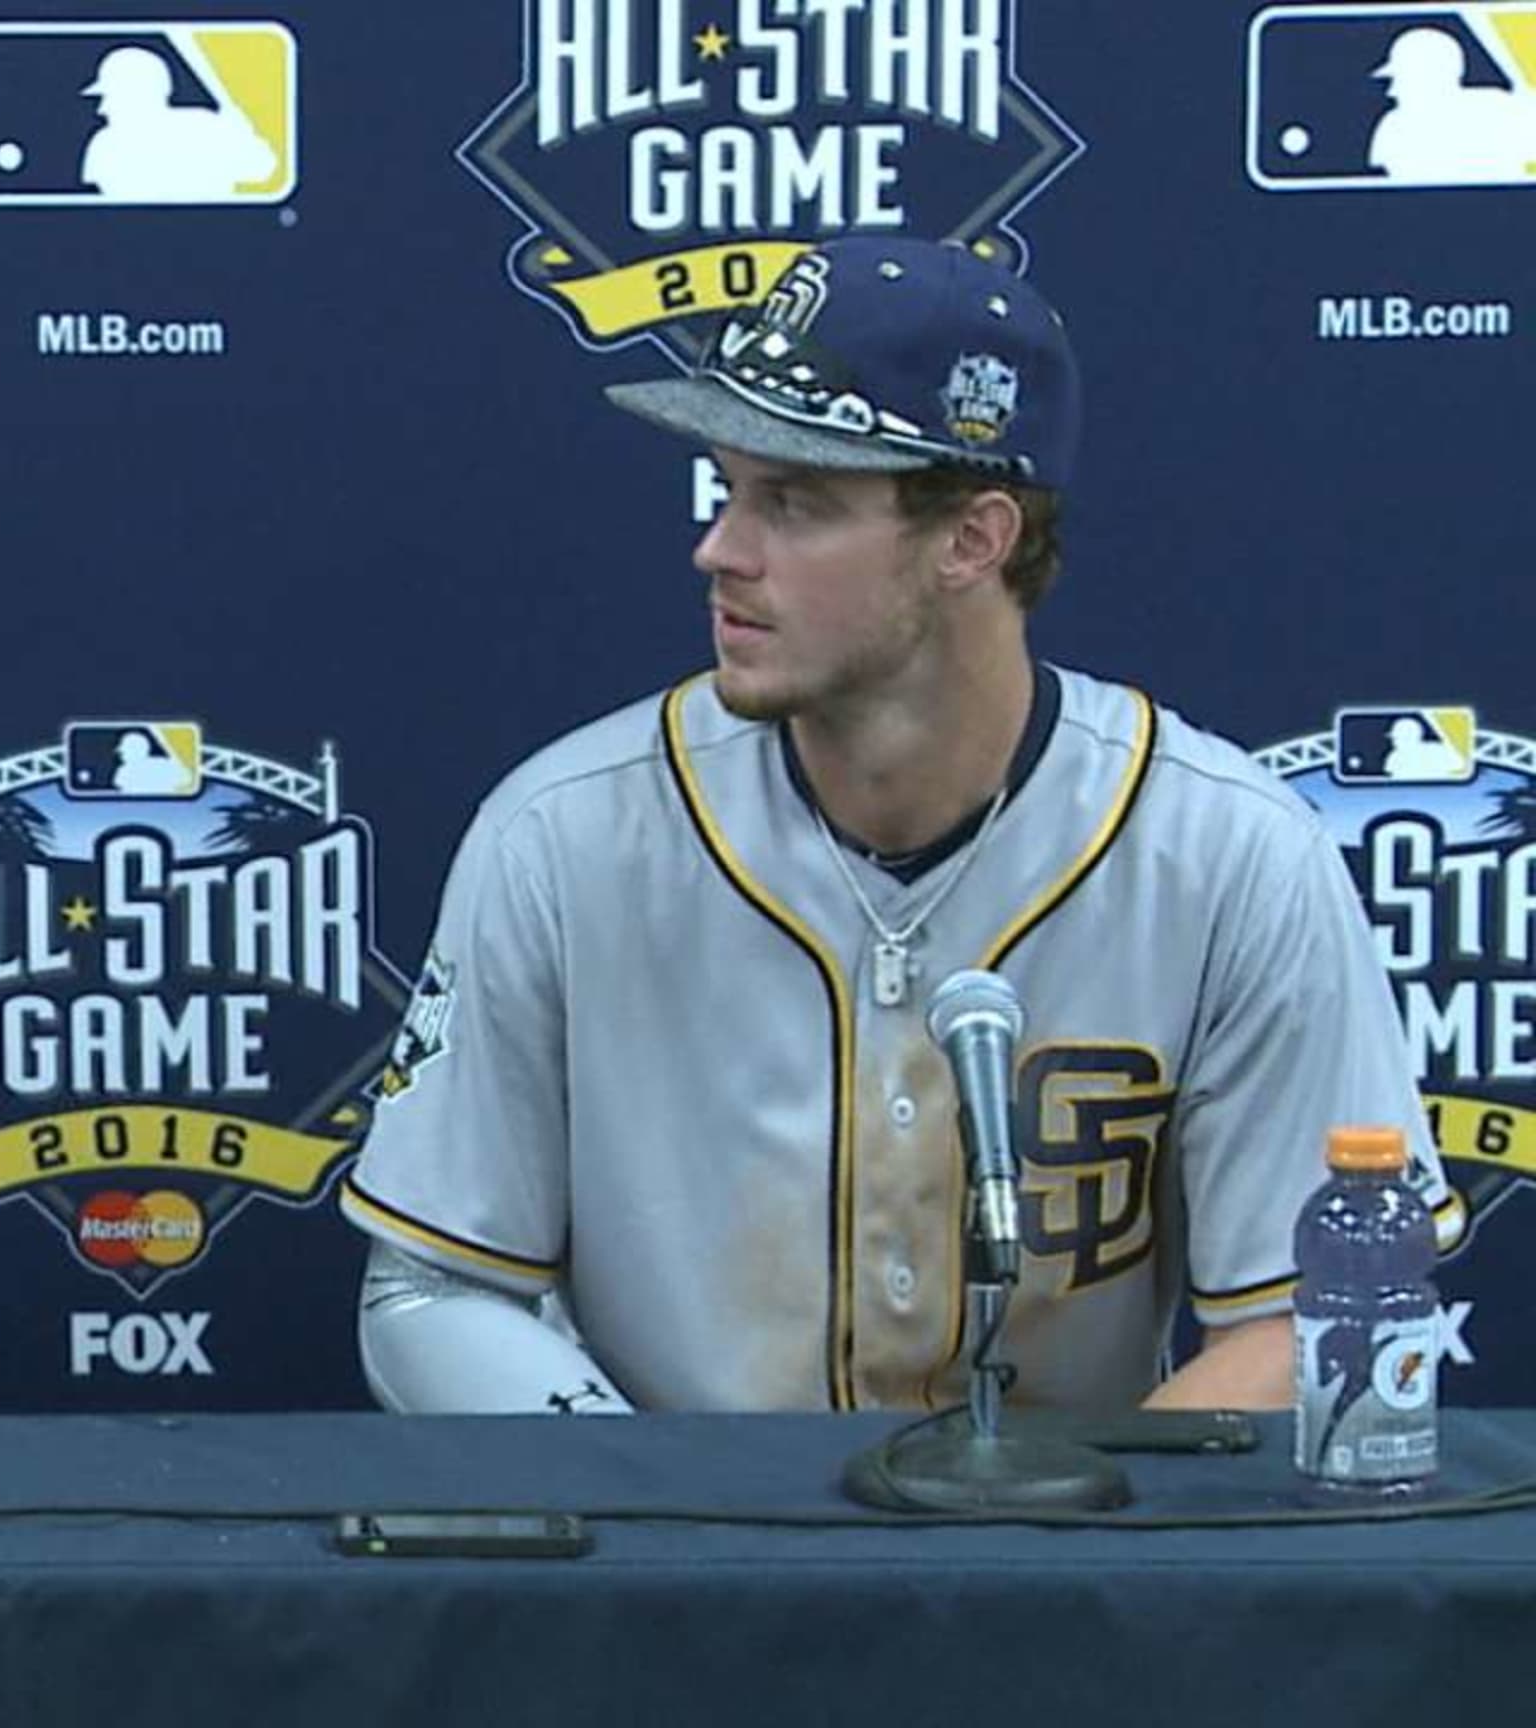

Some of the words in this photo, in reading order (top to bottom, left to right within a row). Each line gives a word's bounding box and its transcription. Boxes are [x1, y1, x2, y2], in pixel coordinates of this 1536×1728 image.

[630, 125, 905, 229] GAME
[656, 253, 756, 308] 20
[38, 314, 224, 354] MLB.com
[1319, 298, 1510, 338] MLB.com
[103, 828, 361, 1010] STAR
[2, 995, 270, 1094] GAME
[1405, 980, 1536, 1078] ME
[29, 1114, 248, 1171] 2016
[1427, 1102, 1516, 1156] 16
[70, 1312, 214, 1375] FOX
